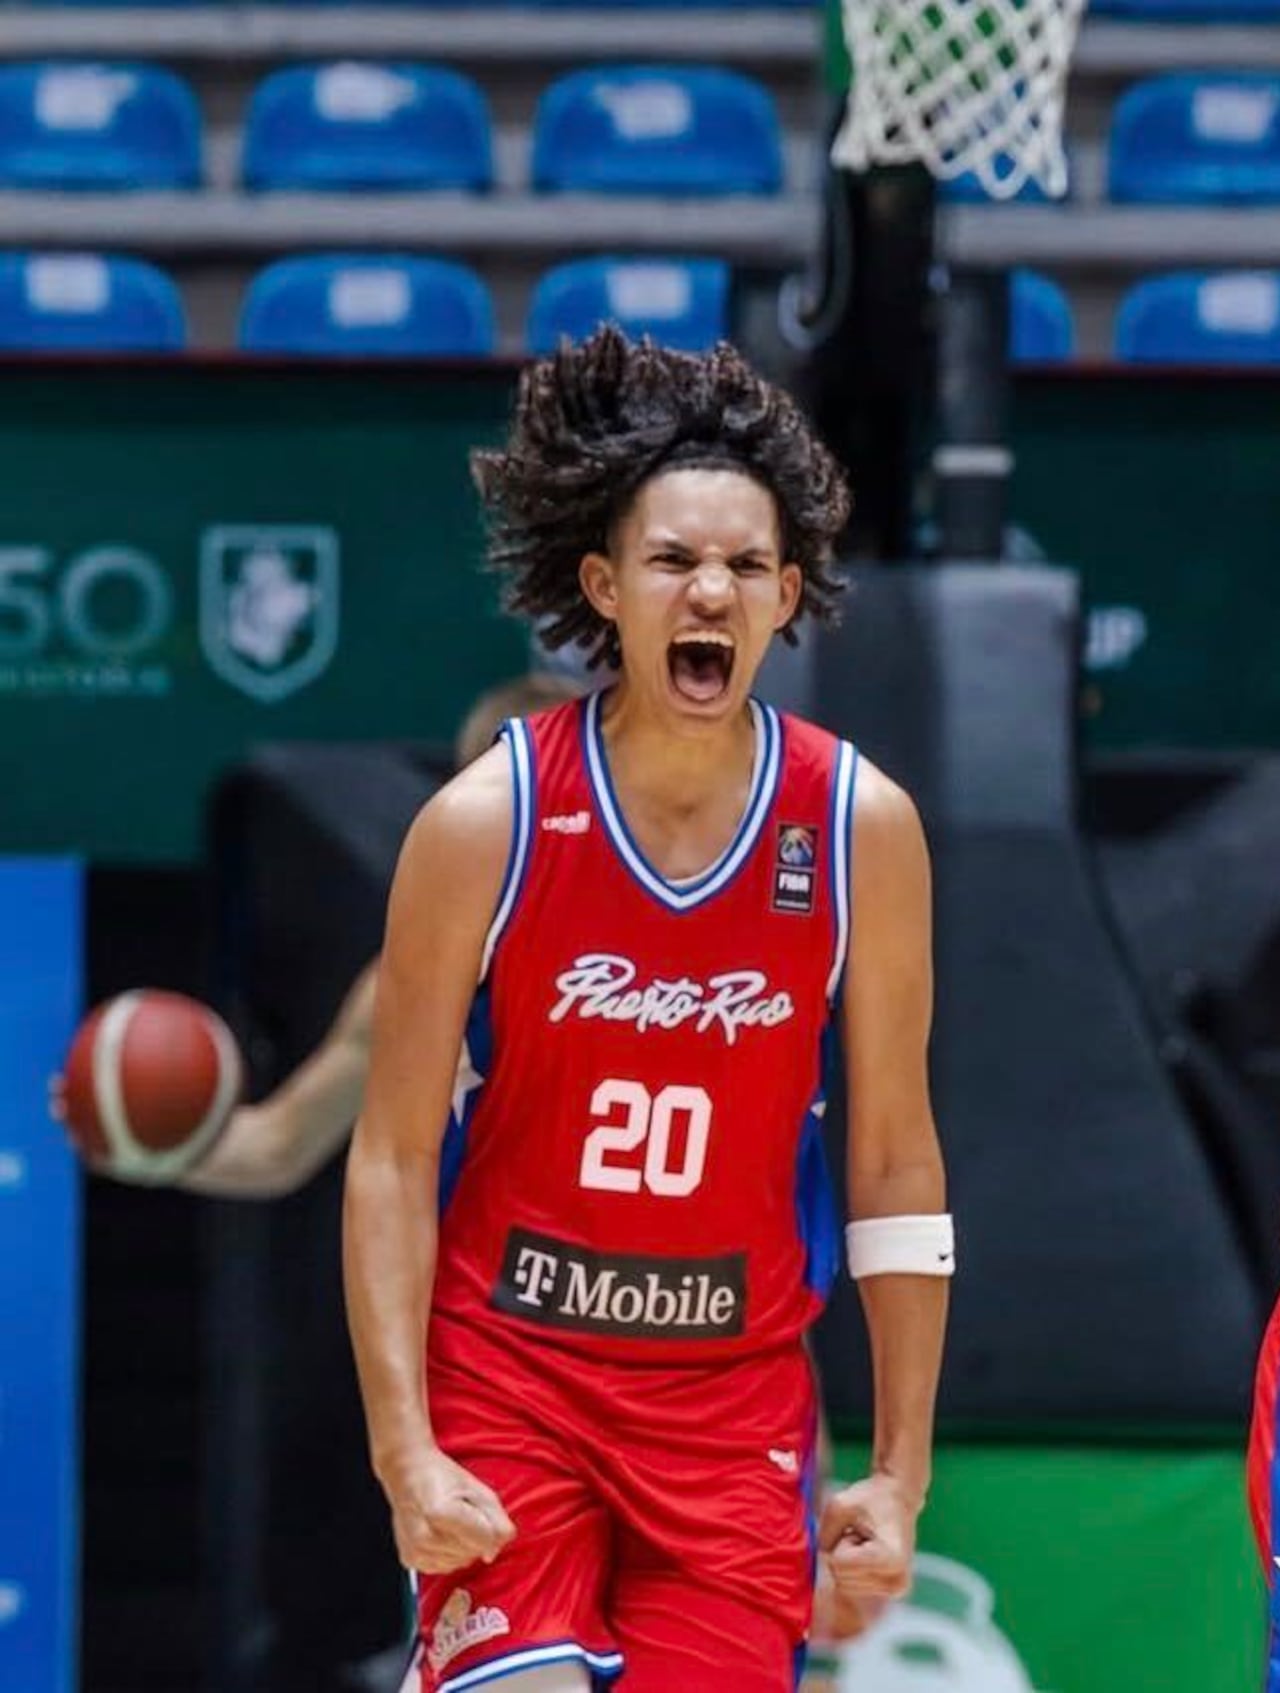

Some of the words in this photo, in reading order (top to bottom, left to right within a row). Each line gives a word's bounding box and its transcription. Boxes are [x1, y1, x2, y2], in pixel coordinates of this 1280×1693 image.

[549, 953, 704, 1034] Puerto
[695, 970, 796, 1047] Rico
[579, 1078, 714, 1197] 20
[558, 1261, 737, 1326] Mobile
